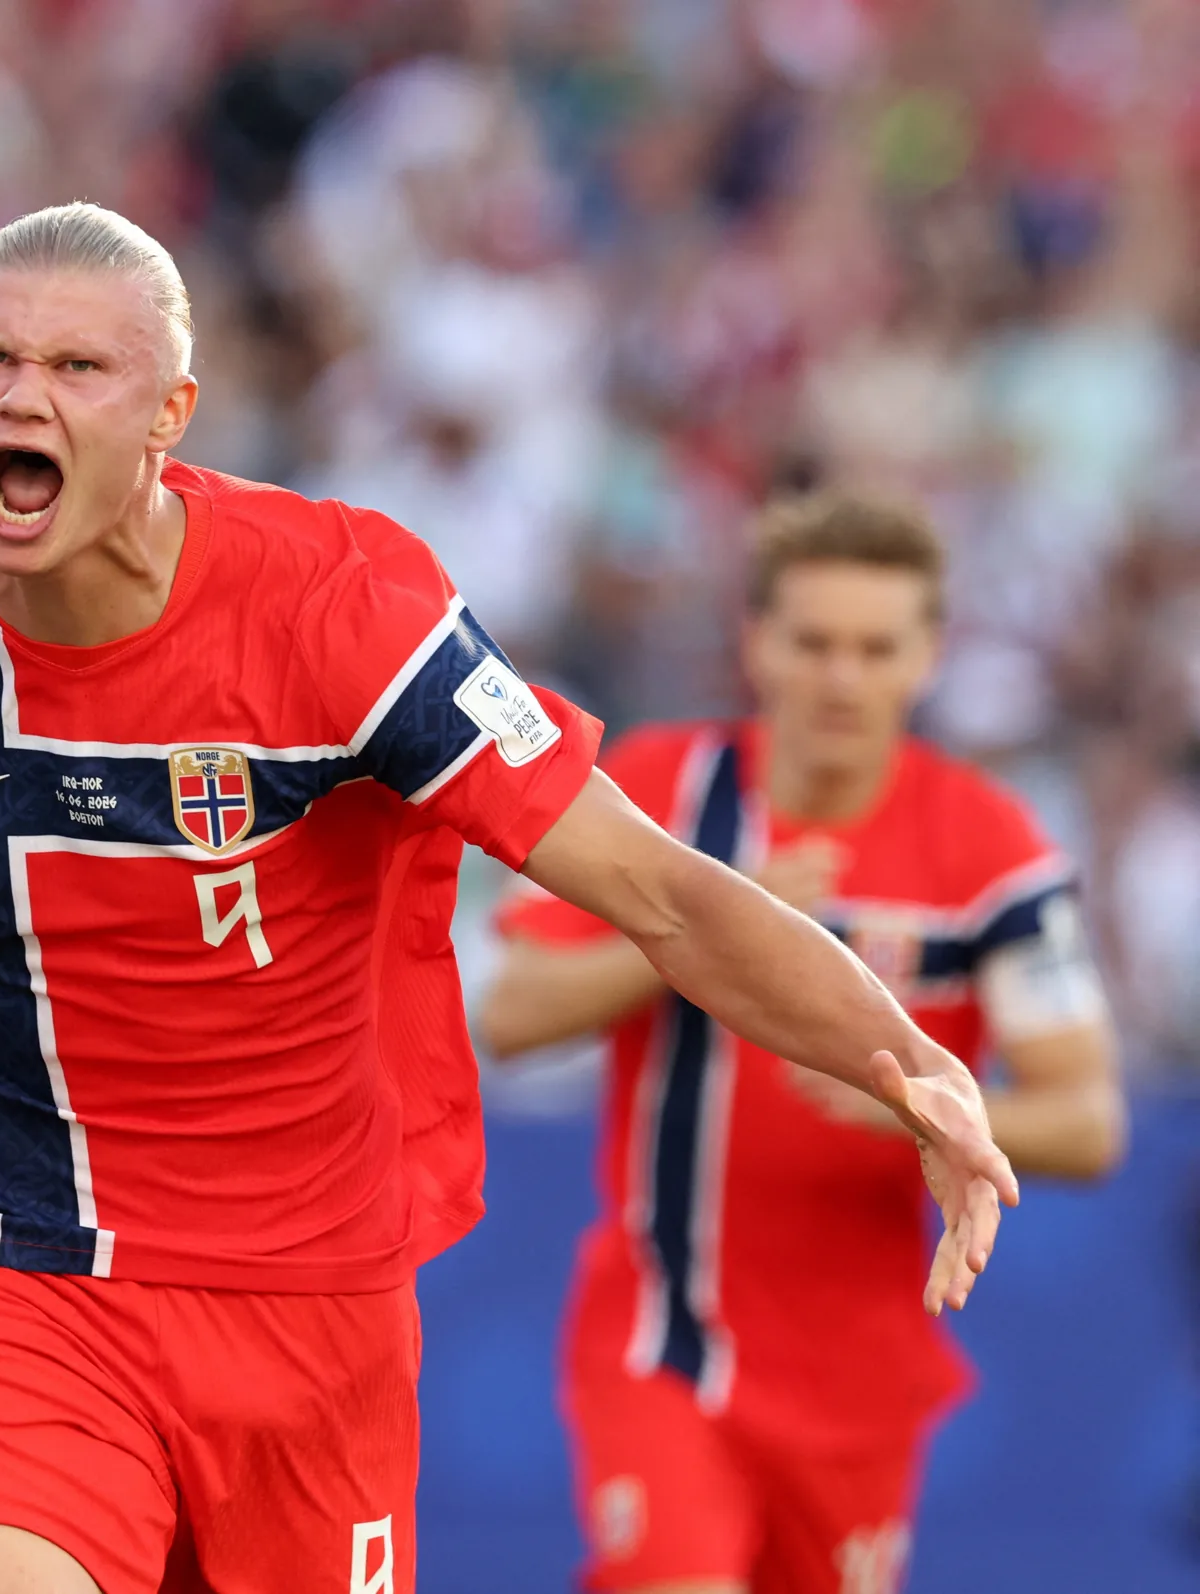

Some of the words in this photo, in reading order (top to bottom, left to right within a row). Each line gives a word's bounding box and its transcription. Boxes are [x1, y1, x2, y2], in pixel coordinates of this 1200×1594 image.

[513, 709, 541, 739] PEACE
[529, 730, 543, 745] FIFA
[195, 751, 220, 761] NORGE
[62, 775, 103, 790] IRQ-NOR
[69, 809, 104, 826] BOSTON
[193, 860, 273, 969] 9
